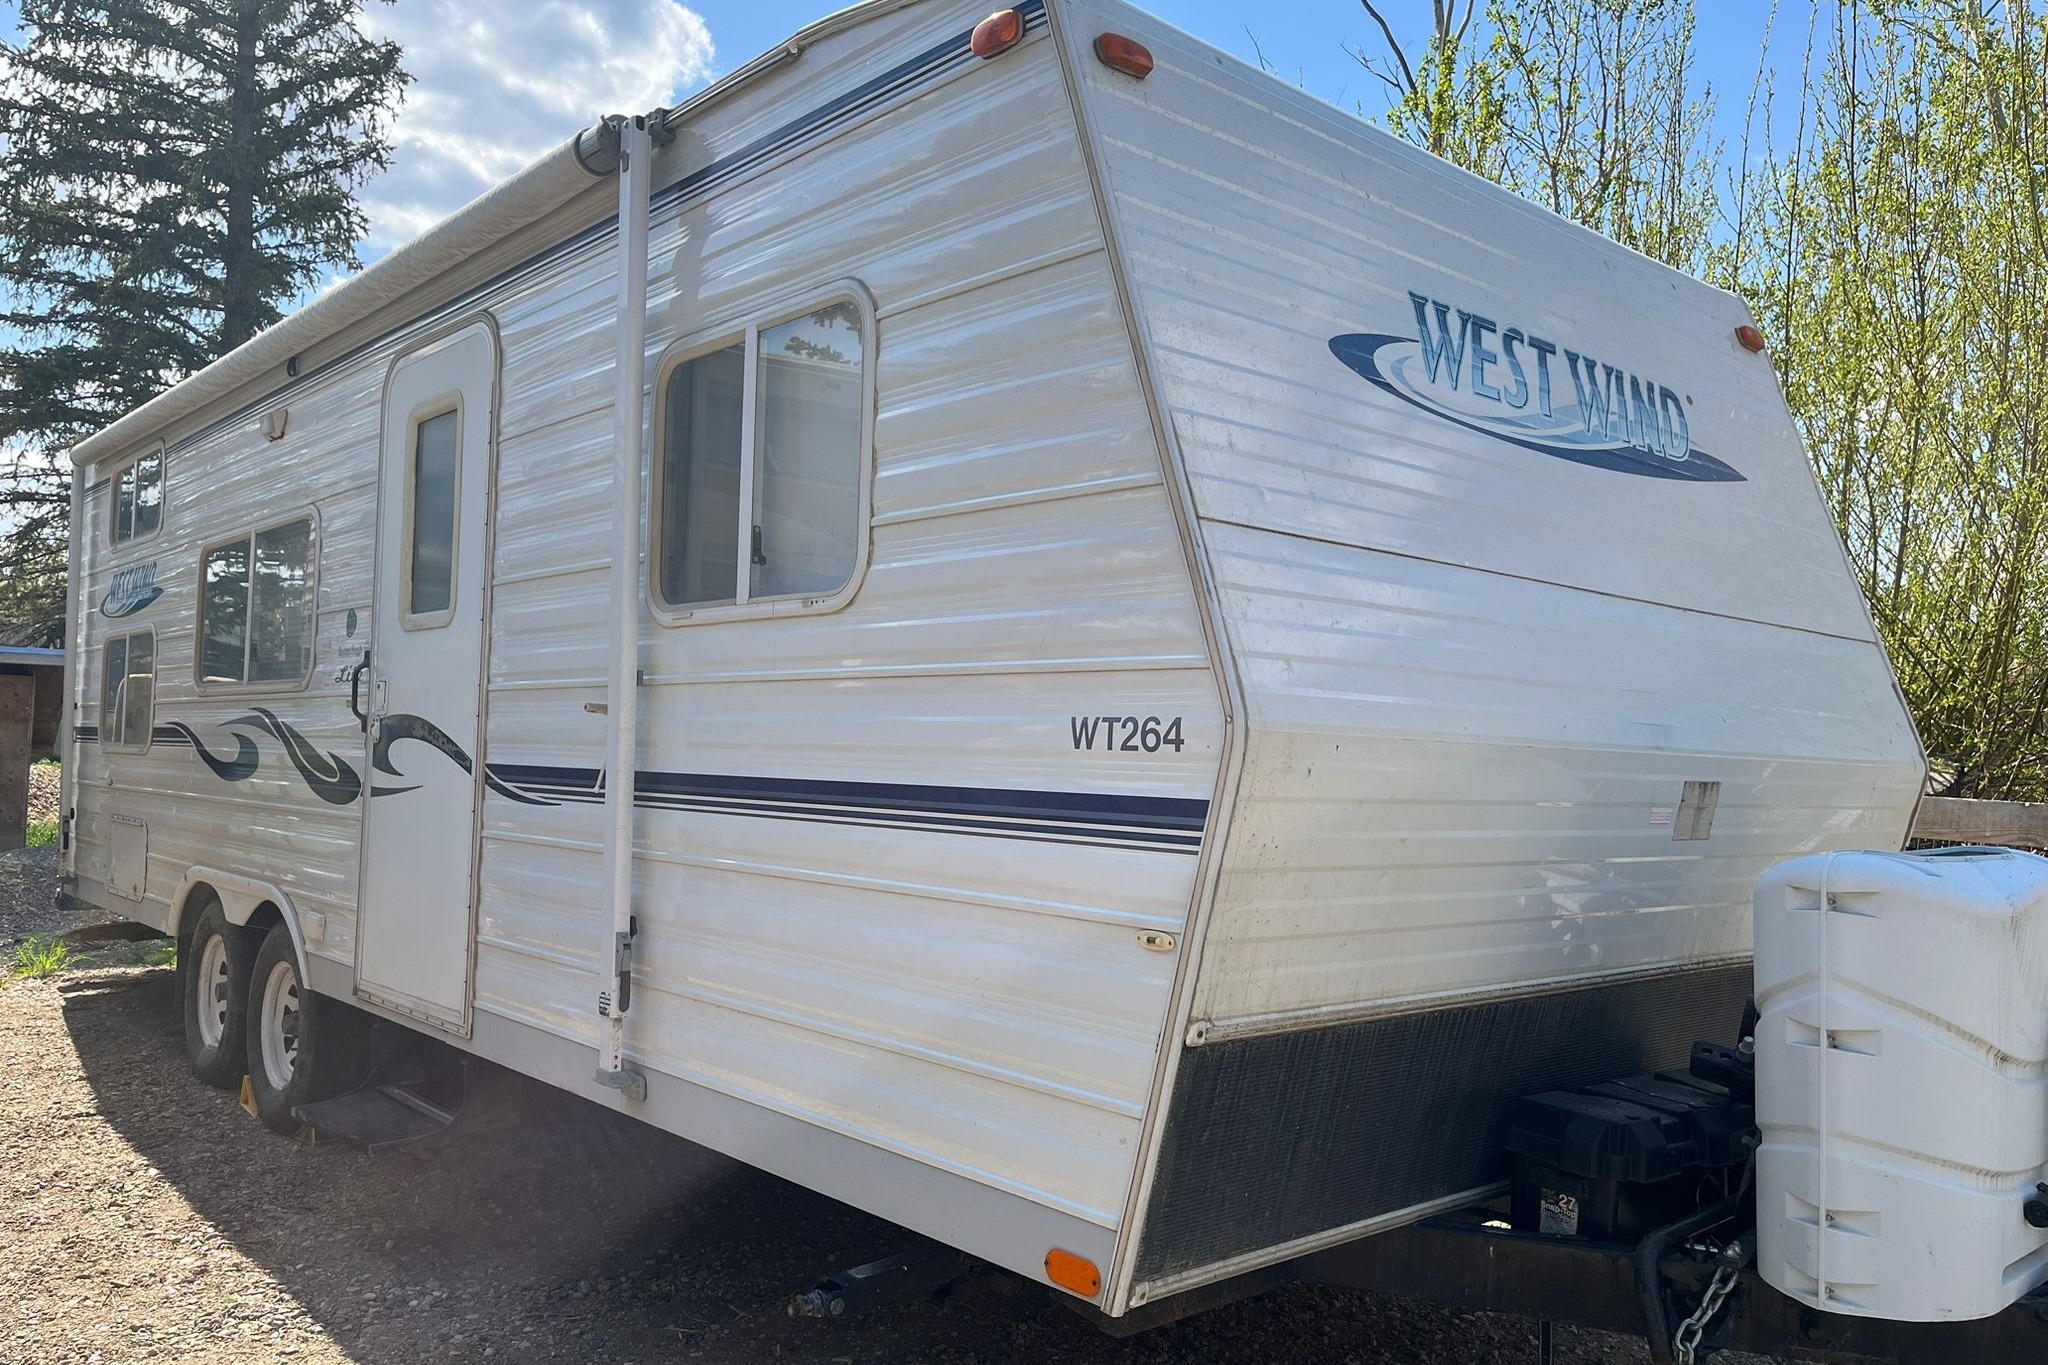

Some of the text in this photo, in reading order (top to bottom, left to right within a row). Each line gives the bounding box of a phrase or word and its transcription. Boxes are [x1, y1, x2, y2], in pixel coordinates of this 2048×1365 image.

[1407, 290, 1690, 461] WEST WIND
[335, 665, 362, 683] Lie
[1071, 716, 1184, 752] WT264
[1558, 1194, 1576, 1210] 27
